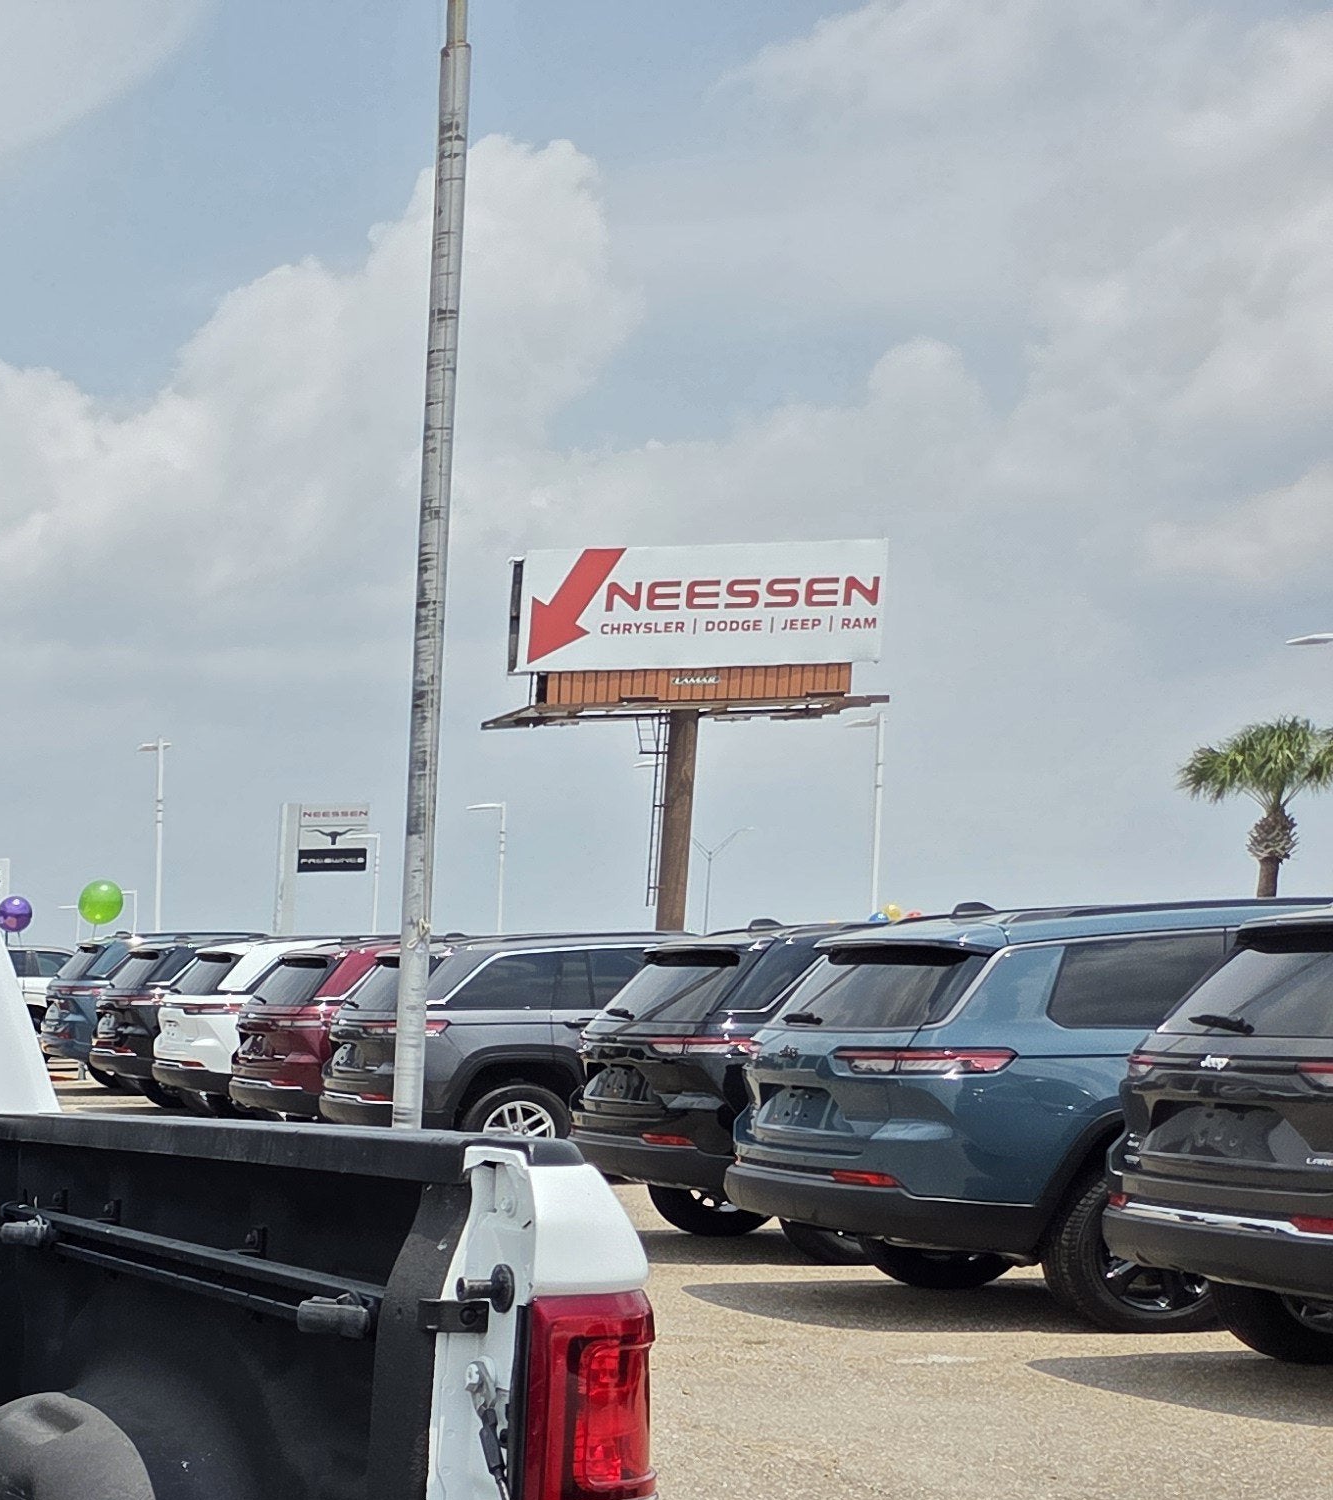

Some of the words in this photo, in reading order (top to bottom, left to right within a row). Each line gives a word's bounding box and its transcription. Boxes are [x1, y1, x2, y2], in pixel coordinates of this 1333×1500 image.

[604, 575, 881, 613] NEESSEN
[599, 621, 686, 635] CHRYSLER
[704, 619, 763, 632] DODGE
[781, 618, 822, 631] JEEP
[840, 617, 877, 630] RAM
[302, 810, 368, 818] NEESSEN
